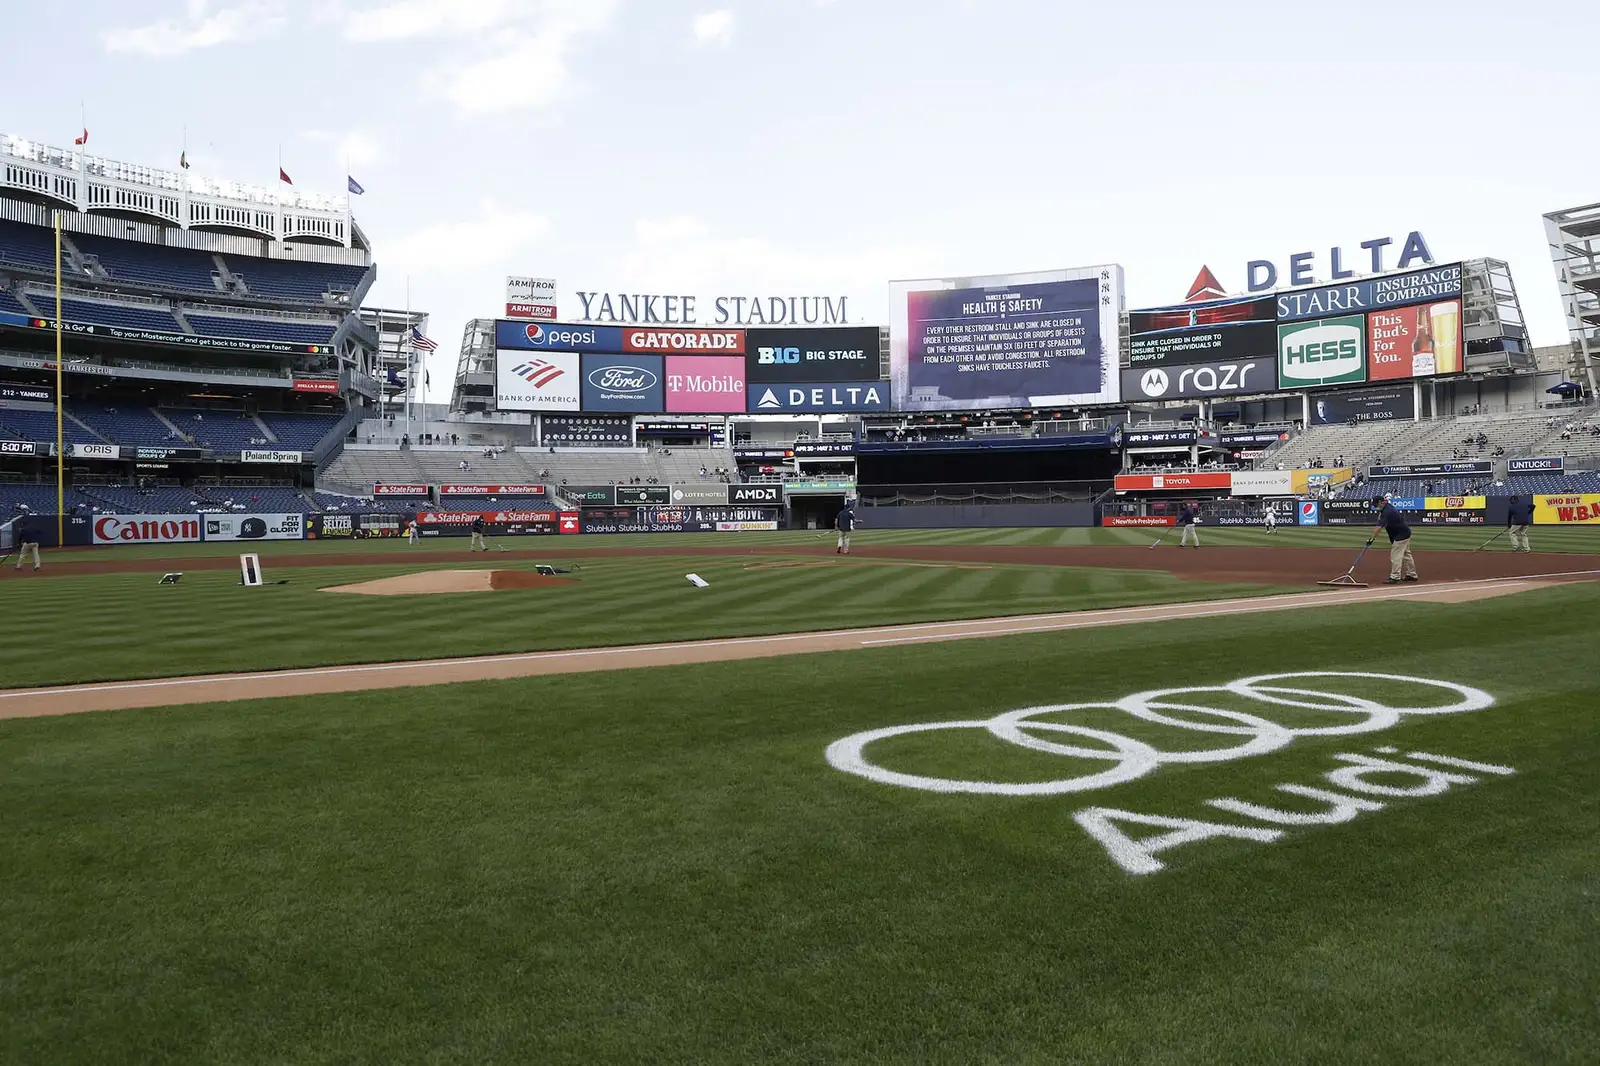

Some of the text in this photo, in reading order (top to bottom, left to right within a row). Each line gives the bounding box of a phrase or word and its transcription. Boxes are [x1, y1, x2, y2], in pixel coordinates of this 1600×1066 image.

[1248, 231, 1435, 292] DELTA
[509, 280, 554, 289] ARMITRON
[1377, 268, 1460, 292] INSURANCE
[1377, 280, 1461, 303] COMPANIES
[576, 292, 848, 324] YANKEE STADIUM
[963, 298, 1042, 314] HEALTH & SAFETY
[1277, 287, 1366, 317] STARR
[511, 305, 552, 313] ARMITRON
[965, 324, 994, 332] RESTROOM
[1053, 319, 1074, 327] CLOSED
[1372, 315, 1402, 327] This
[110, 328, 122, 336] Tap
[550, 330, 595, 346] pepsi
[988, 332, 1022, 341] INDIVIDUALS
[1032, 330, 1054, 338] GROUPS
[1064, 328, 1085, 336] GUESTS
[1374, 326, 1408, 339] Bud's
[630, 332, 737, 349] GATORADE
[948, 345, 975, 353] PREMISES
[976, 343, 1002, 352] MAINTAIN
[1047, 338, 1081, 347] SEPARATION
[1172, 342, 1211, 350] INDIVIDUALS
[1374, 342, 1395, 352] For
[806, 350, 866, 360] BIG STAGE.
[1006, 351, 1040, 360] CONGESTION.
[1056, 348, 1085, 357] RESTROOM
[1287, 339, 1356, 364] HESS
[1374, 353, 1401, 364] You.
[68, 365, 96, 374] YANKEES
[992, 362, 1023, 370] TOUCHLESS
[601, 368, 644, 388] Ford
[1179, 363, 1255, 392] razr
[789, 387, 880, 405] DELTA
[1, 443, 33, 452] 6:00 PM
[84, 446, 112, 454] ORIS
[245, 451, 298, 462] Poland Spring
[1512, 461, 1551, 469] UNTUCKit
[735, 490, 765, 499] AMD
[95, 518, 198, 540] Canon
[323, 520, 351, 528] SELTZER
[1071, 747, 1517, 874] Audi
